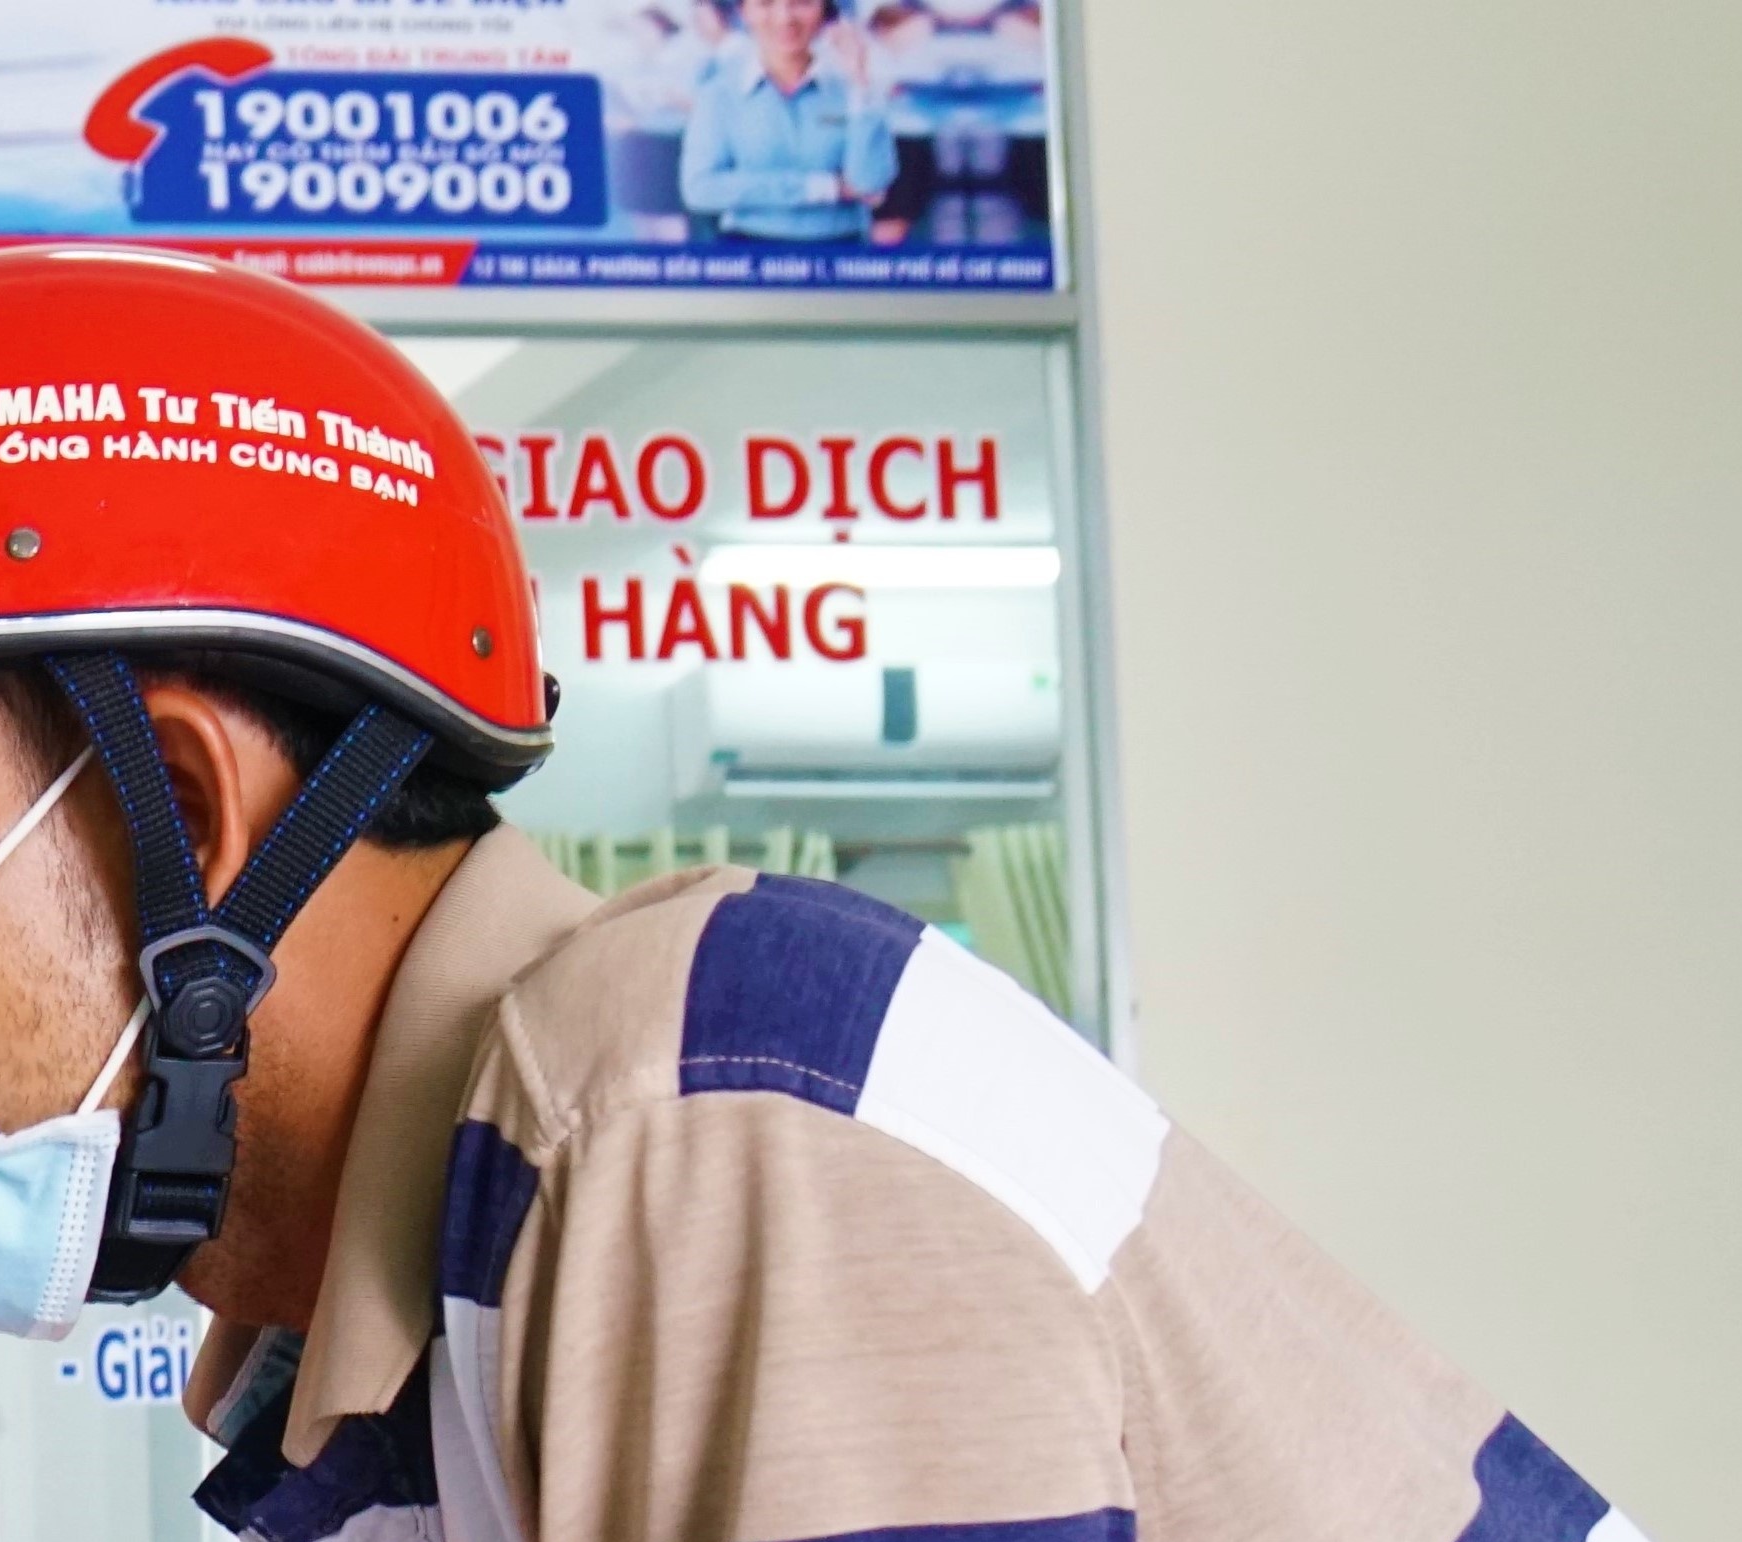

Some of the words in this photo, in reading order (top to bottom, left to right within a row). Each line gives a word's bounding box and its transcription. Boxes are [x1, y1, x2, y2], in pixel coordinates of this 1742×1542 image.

[194, 89, 569, 142] 19001006
[198, 162, 572, 212] 19009000
[137, 387, 199, 425] Tư
[103, 430, 218, 464] HÀNH
[229, 441, 340, 482] CÙNG
[350, 463, 419, 508] BẠN
[743, 433, 1001, 543] DỊCH
[581, 544, 868, 664] HÀNG
